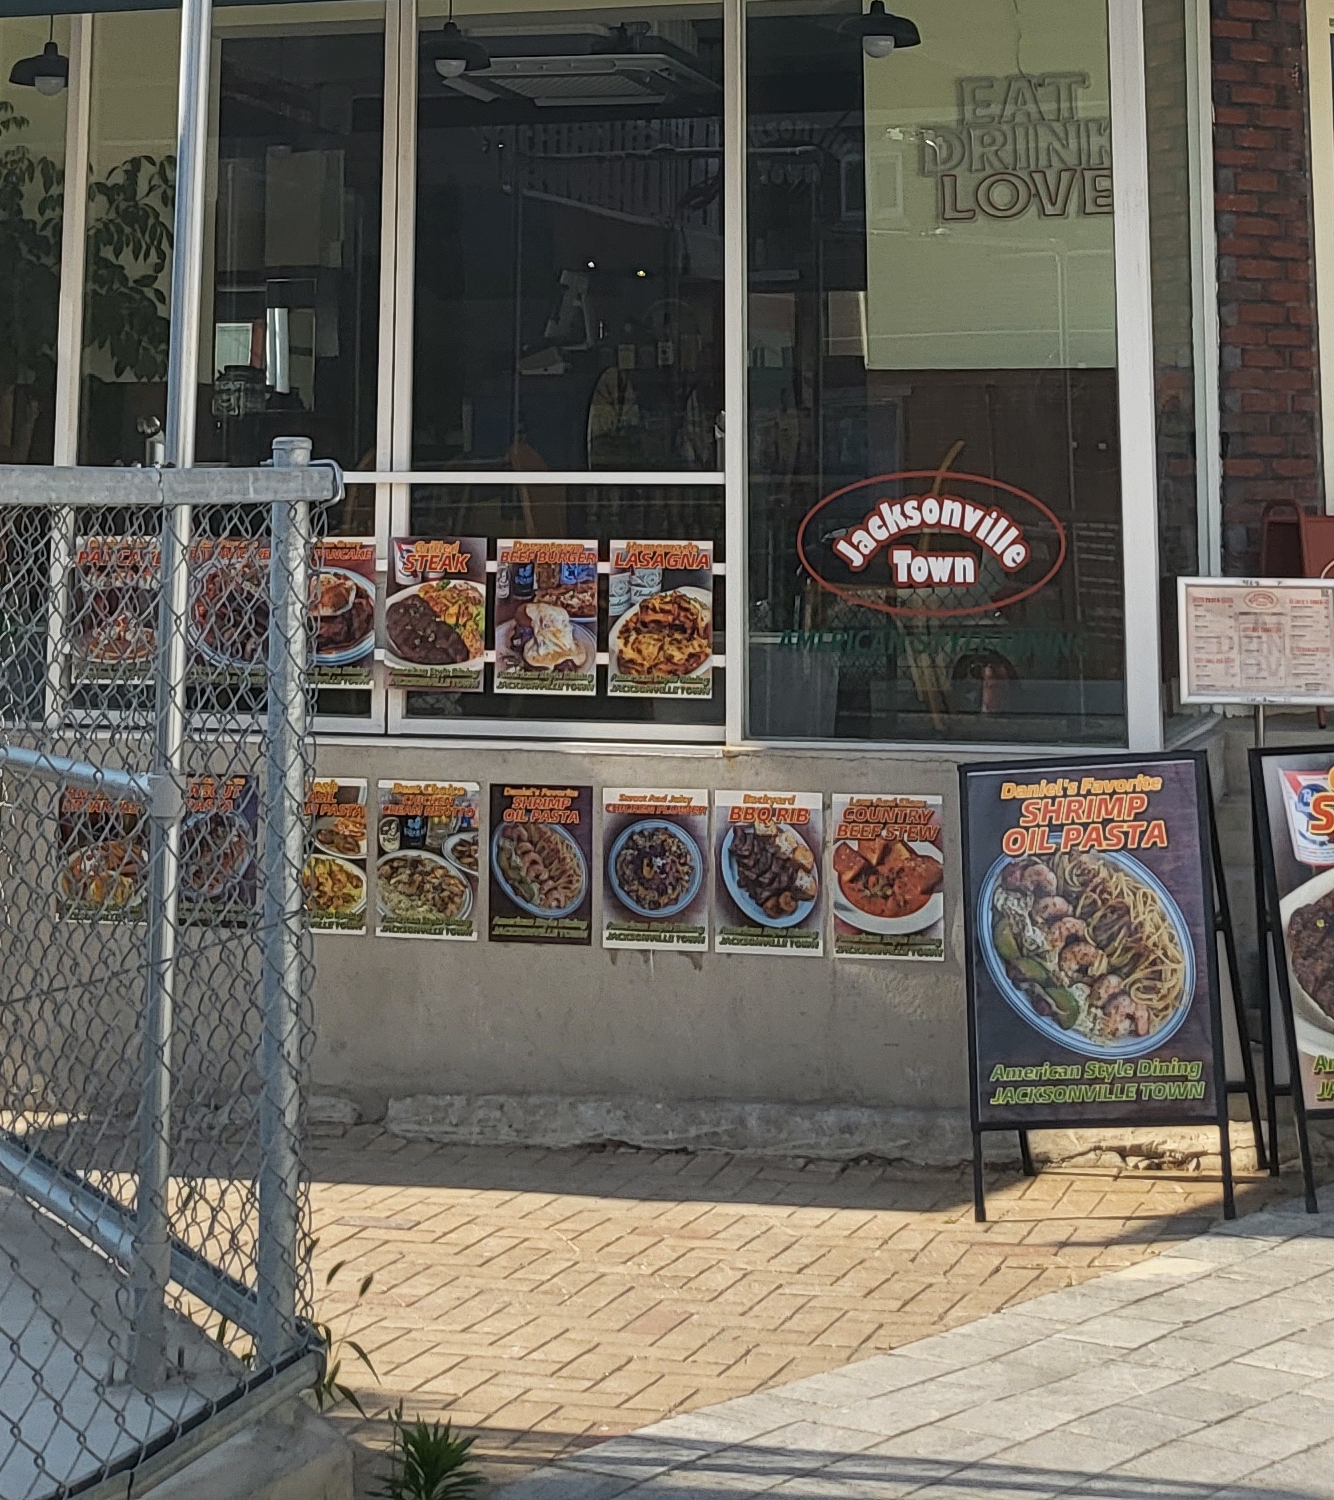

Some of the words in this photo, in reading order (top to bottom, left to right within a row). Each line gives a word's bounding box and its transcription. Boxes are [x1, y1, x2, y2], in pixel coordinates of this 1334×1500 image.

[959, 74, 1089, 126] EAT
[941, 167, 1113, 221] LOVE
[835, 495, 1028, 569] Jacksonville
[403, 553, 471, 573] STEAK
[500, 551, 535, 563] BEEF
[536, 551, 597, 564] BURGER
[614, 552, 710, 569] LASAGNA
[891, 548, 976, 584] Town
[1000, 778, 1080, 800] Daniel's
[1080, 773, 1163, 795] Favorite
[308, 791, 338, 804] ASIL
[512, 796, 572, 810] SHRIMP
[320, 804, 367, 819] PASTA
[503, 809, 528, 823] OIL
[530, 810, 580, 824] PASTA
[729, 806, 773, 824] BBQ
[774, 806, 810, 824] RIB
[842, 806, 935, 824] COUNTRY
[1019, 793, 1148, 827] SHRIMP
[836, 823, 884, 839] BEEF
[886, 824, 940, 841] STEW
[1002, 826, 1055, 856] OIL
[1060, 820, 1168, 852] PASTA
[990, 1060, 1081, 1082] American
[1085, 1058, 1134, 1080] Style
[1137, 1057, 1203, 1079] Dining
[990, 1083, 1140, 1105] JACKSONVILLE
[1140, 1080, 1206, 1100] TOWN
